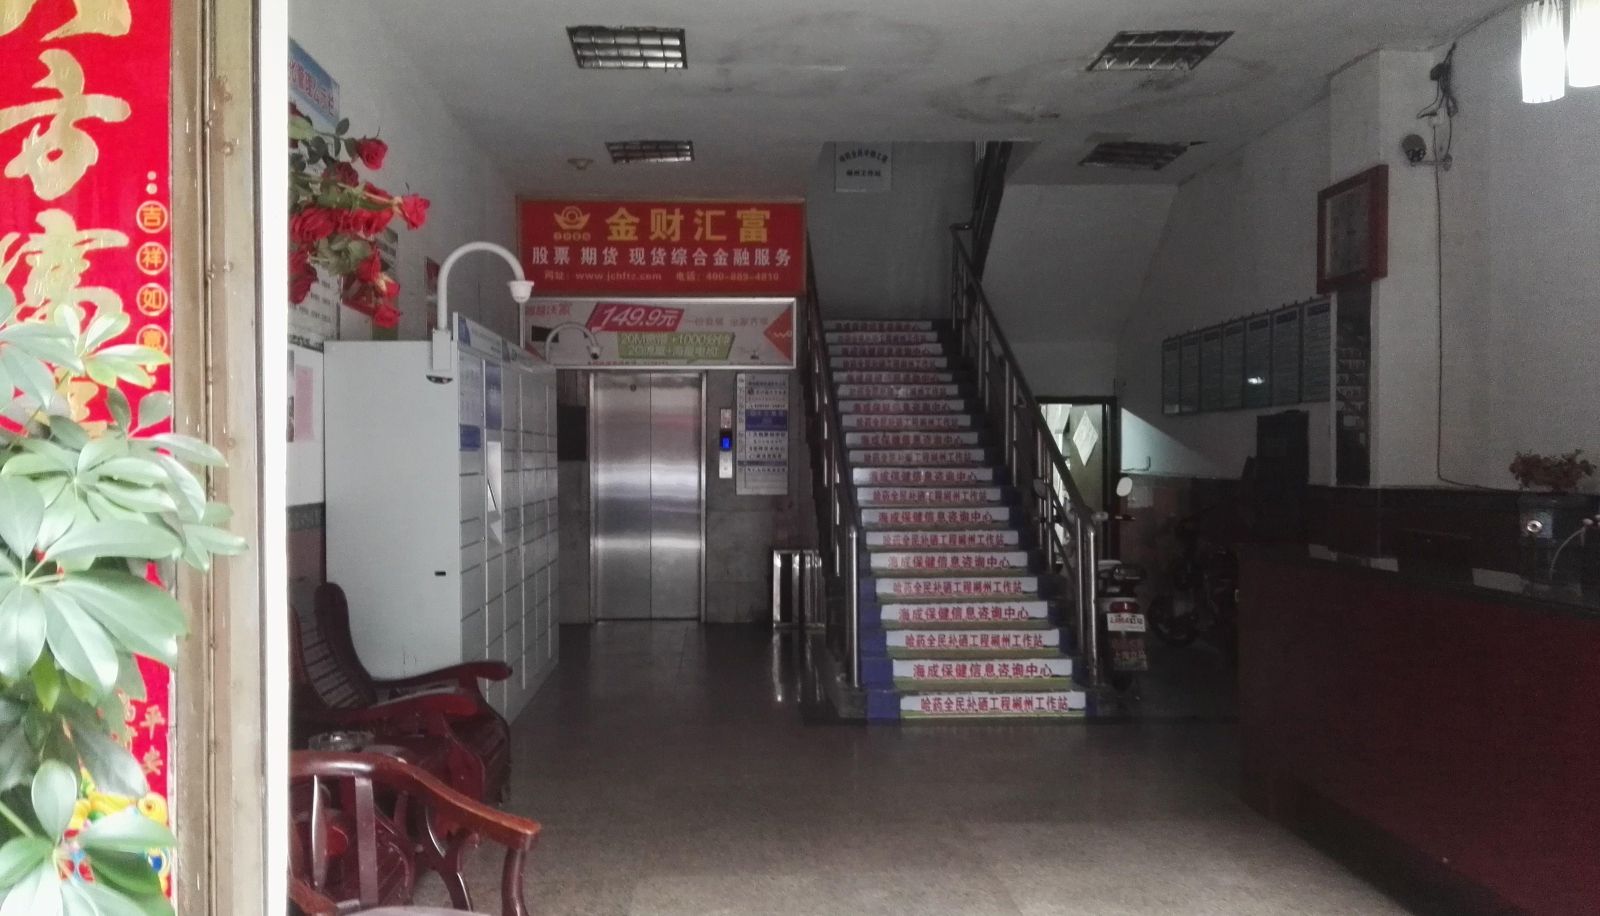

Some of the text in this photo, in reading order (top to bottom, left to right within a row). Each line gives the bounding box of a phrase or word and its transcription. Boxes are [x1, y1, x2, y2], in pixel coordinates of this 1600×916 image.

[605, 207, 771, 243] 金财汇富
[532, 246, 791, 266] 股票 期货 现货综合金融服务
[898, 606, 1029, 621] 海成保健信息咨询中心
[912, 663, 1052, 678] 海成保健信息咨询中心
[921, 696, 1068, 713] 哈药全民补硒工程郴州工作站
